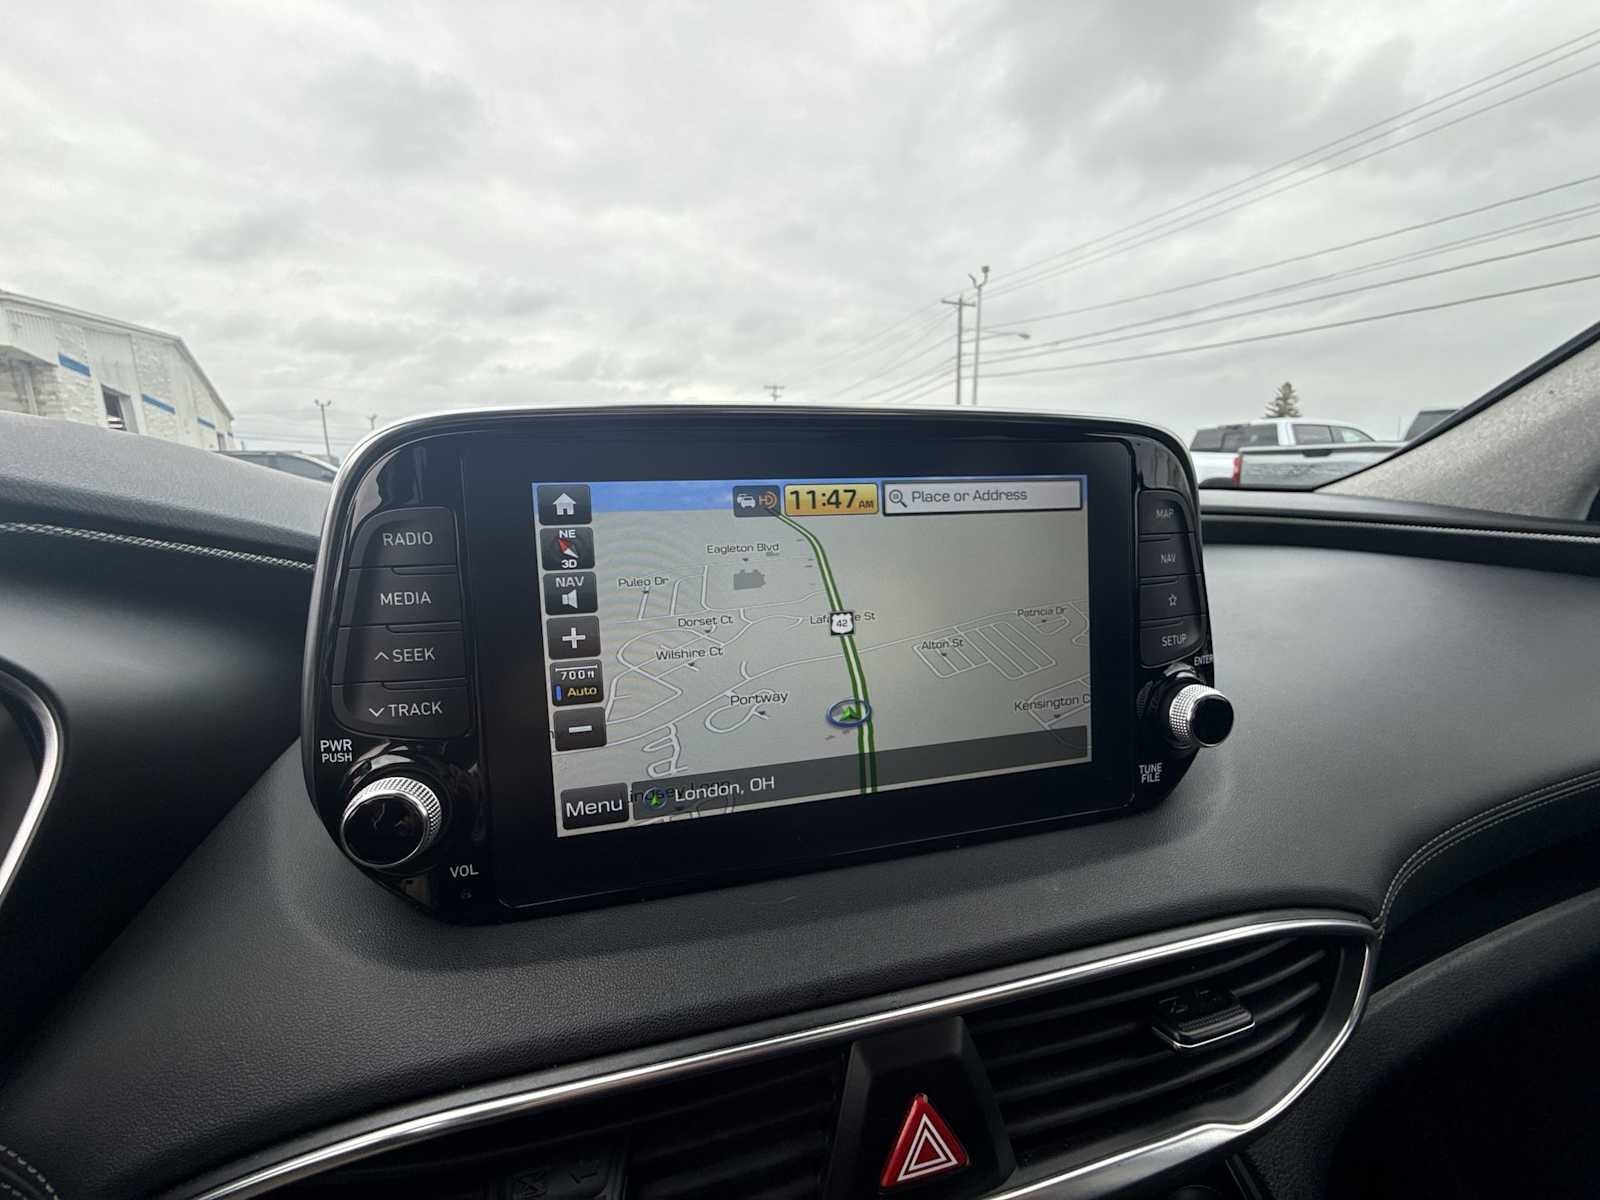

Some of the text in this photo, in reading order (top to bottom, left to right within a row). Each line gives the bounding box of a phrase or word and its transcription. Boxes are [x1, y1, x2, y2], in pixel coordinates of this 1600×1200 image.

[789, 488, 874, 511] 11:47 AM
[911, 489, 1028, 503] Place or Address
[1155, 508, 1174, 520] MAP
[382, 531, 433, 547] RADIO
[559, 529, 576, 539] NE
[706, 542, 780, 556] Eagleton Blvd
[561, 559, 577, 569] 3D
[1160, 553, 1176, 565] NAV
[555, 576, 584, 588] NAV
[618, 576, 669, 588] Puleo Dr
[380, 591, 431, 606] MEDIA
[864, 611, 876, 621] St
[1017, 605, 1067, 617] Patricia Dr
[677, 615, 734, 628] Dorset Ct
[836, 619, 848, 628] 42
[921, 638, 964, 650] Alton St
[1161, 633, 1187, 647] SETUP
[392, 648, 435, 663] SEEK
[655, 646, 724, 661] Wilshire Ct
[567, 686, 598, 698] Auto
[730, 691, 789, 707] Portway
[1014, 695, 1080, 712] Kensington
[387, 701, 443, 718] TRACK
[320, 738, 353, 752] PWR
[321, 752, 353, 764] PUSH
[1138, 762, 1163, 774] TUNE
[1140, 772, 1161, 784] FILE
[674, 782, 745, 803] London,
[749, 775, 776, 792] OH
[565, 799, 624, 819] Menu
[449, 864, 480, 879] VOL
